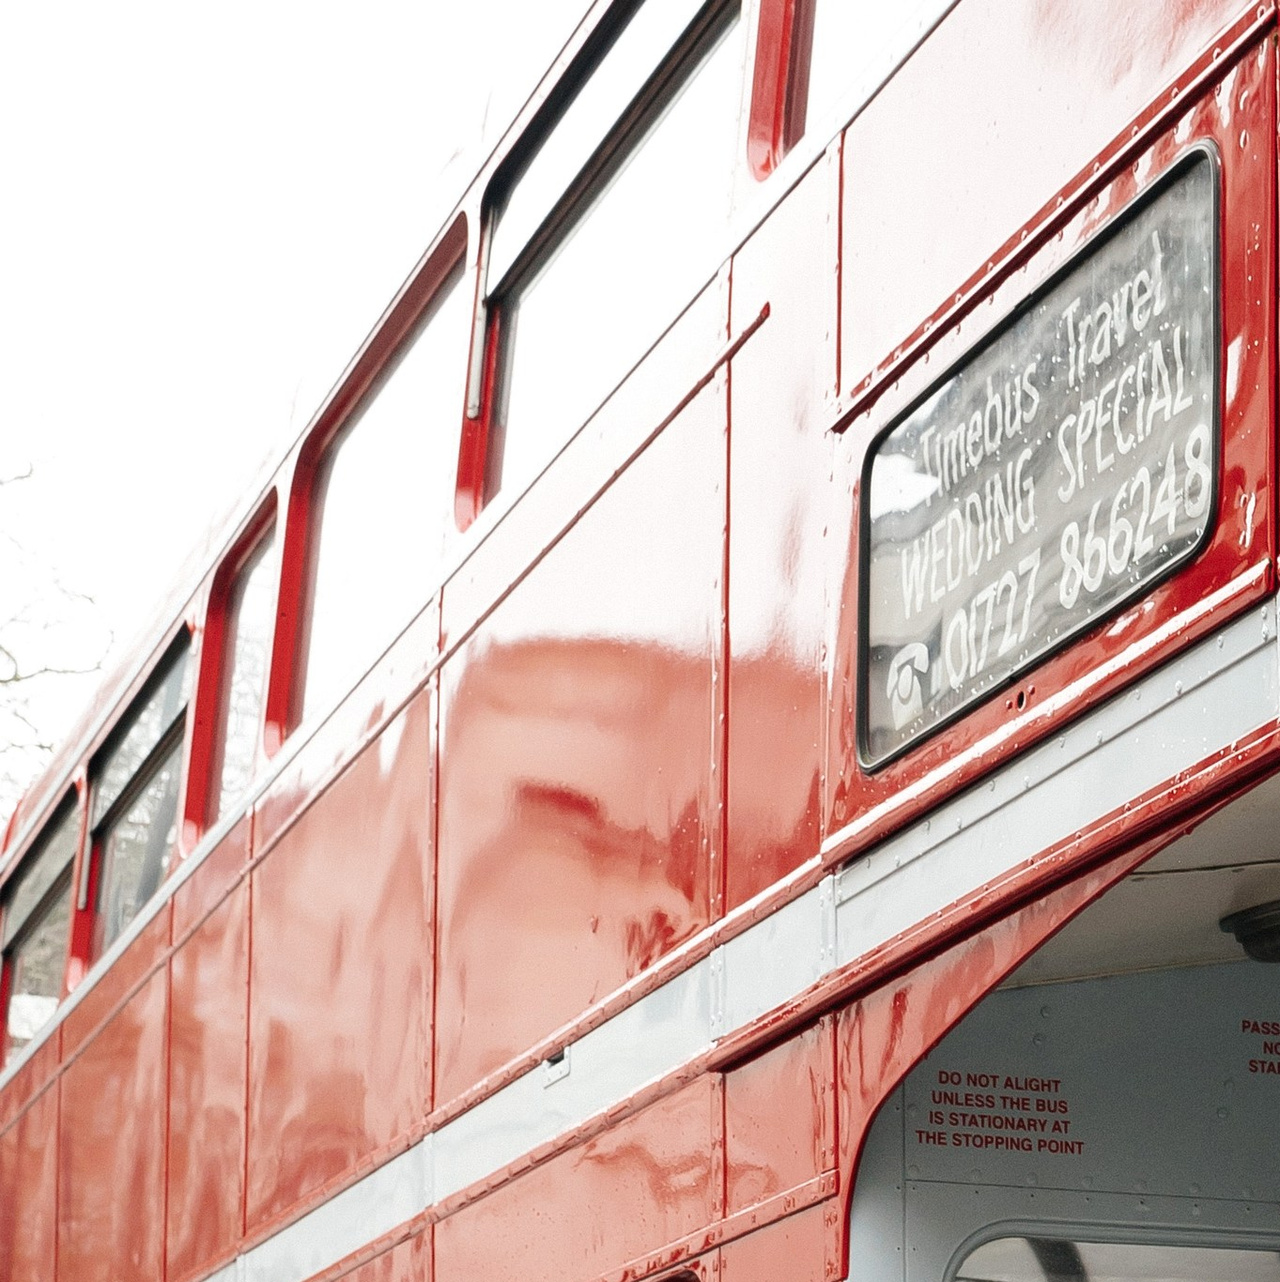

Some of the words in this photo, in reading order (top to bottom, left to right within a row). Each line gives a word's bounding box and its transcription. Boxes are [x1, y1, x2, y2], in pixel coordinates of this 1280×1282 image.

[920, 361, 1041, 506] Timebus
[1060, 230, 1168, 388] Travel
[901, 447, 1036, 620] WEDDING
[1057, 325, 1193, 504] SPECIAL
[946, 547, 1042, 691] 01727
[1060, 422, 1213, 610] 866248
[938, 1070, 962, 1086] DO
[966, 1073, 1000, 1089] NOT
[1003, 1076, 1061, 1093] ALIGHT
[931, 1090, 995, 1108] UNLESS
[1000, 1095, 1031, 1111] THE
[1035, 1098, 1068, 1114] BUS
[929, 1110, 945, 1125] IS
[949, 1112, 1047, 1132] STATIONARY
[1052, 1120, 1071, 1134] AT
[915, 1130, 947, 1146] THE
[952, 1132, 1033, 1151] STOPPING
[1037, 1139, 1085, 1155] POINT
